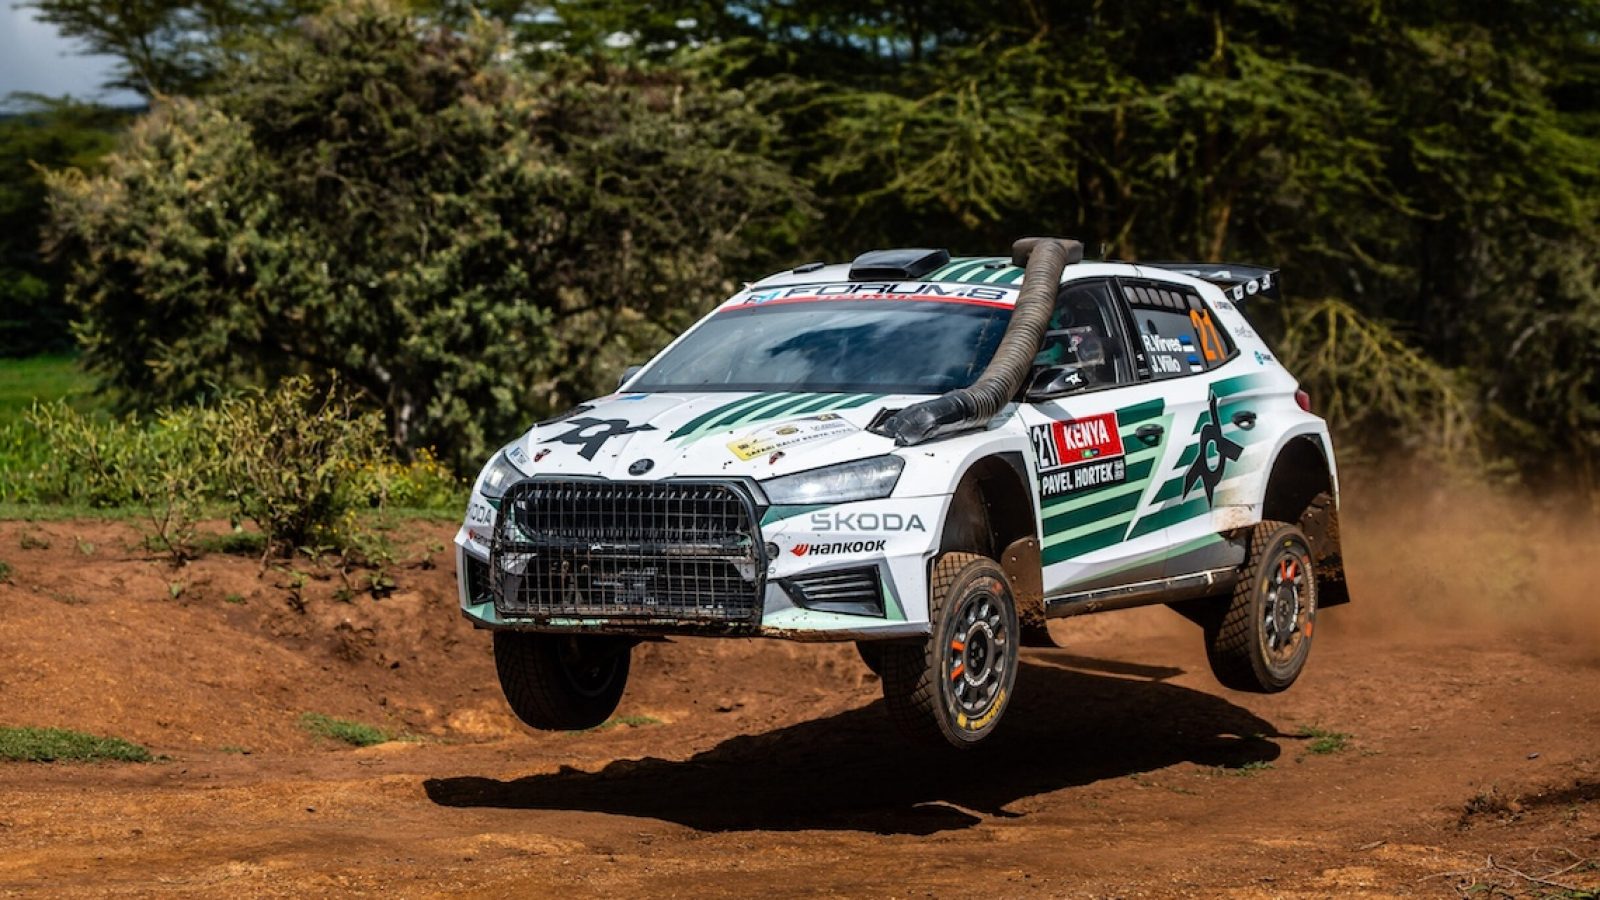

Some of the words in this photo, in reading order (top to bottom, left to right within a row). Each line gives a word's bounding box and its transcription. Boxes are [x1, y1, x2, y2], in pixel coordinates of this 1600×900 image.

[784, 283, 1008, 300] FORUM8
[1189, 308, 1227, 362] 21
[1032, 424, 1058, 467] 21
[1063, 419, 1110, 450] KENYA
[1042, 471, 1074, 496] PAVEL
[1074, 462, 1114, 489] HORTEK
